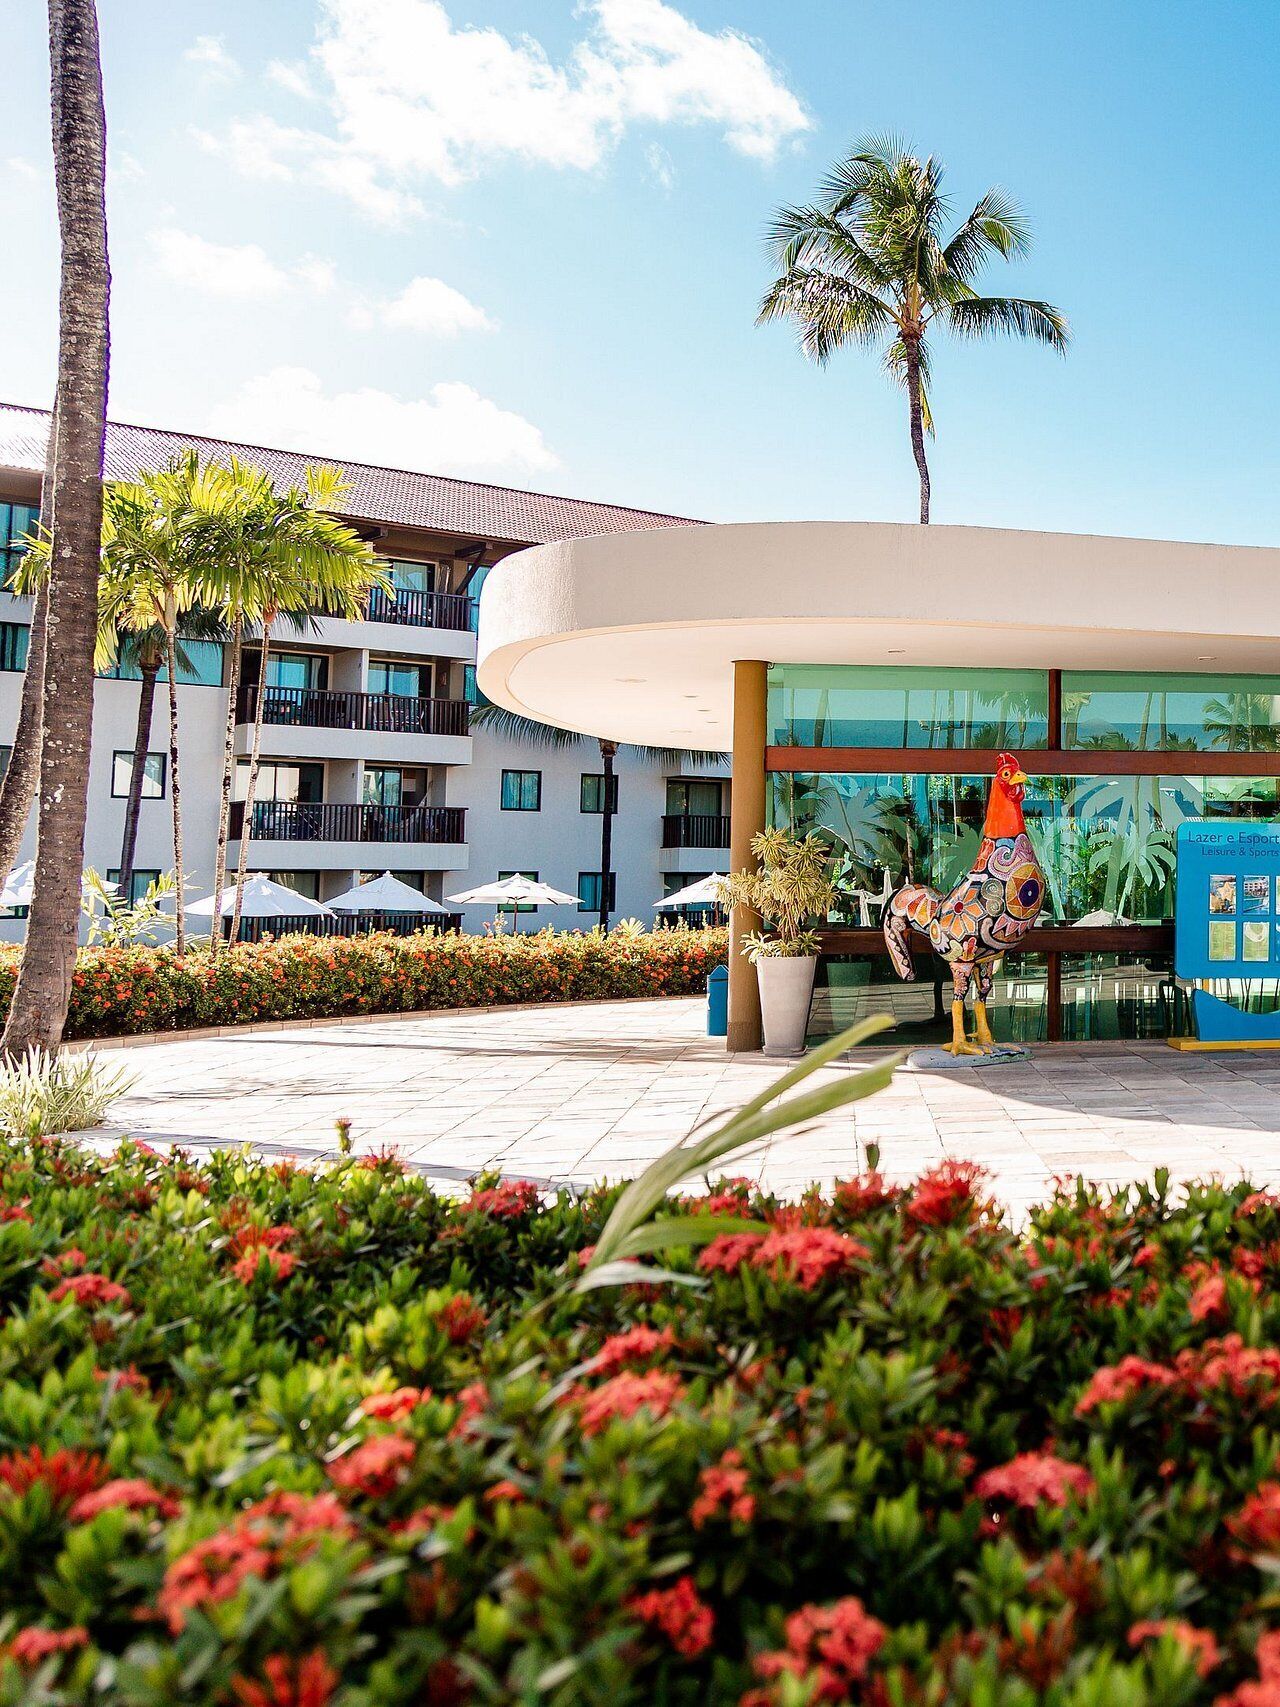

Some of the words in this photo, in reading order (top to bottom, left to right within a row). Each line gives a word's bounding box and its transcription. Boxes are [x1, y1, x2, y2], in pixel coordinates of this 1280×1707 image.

[1188, 831, 1222, 843] Lazer
[1227, 834, 1235, 843] e
[1202, 846, 1236, 856] Leisure
[1239, 847, 1246, 856] &
[1250, 848, 1279, 859] Sports
